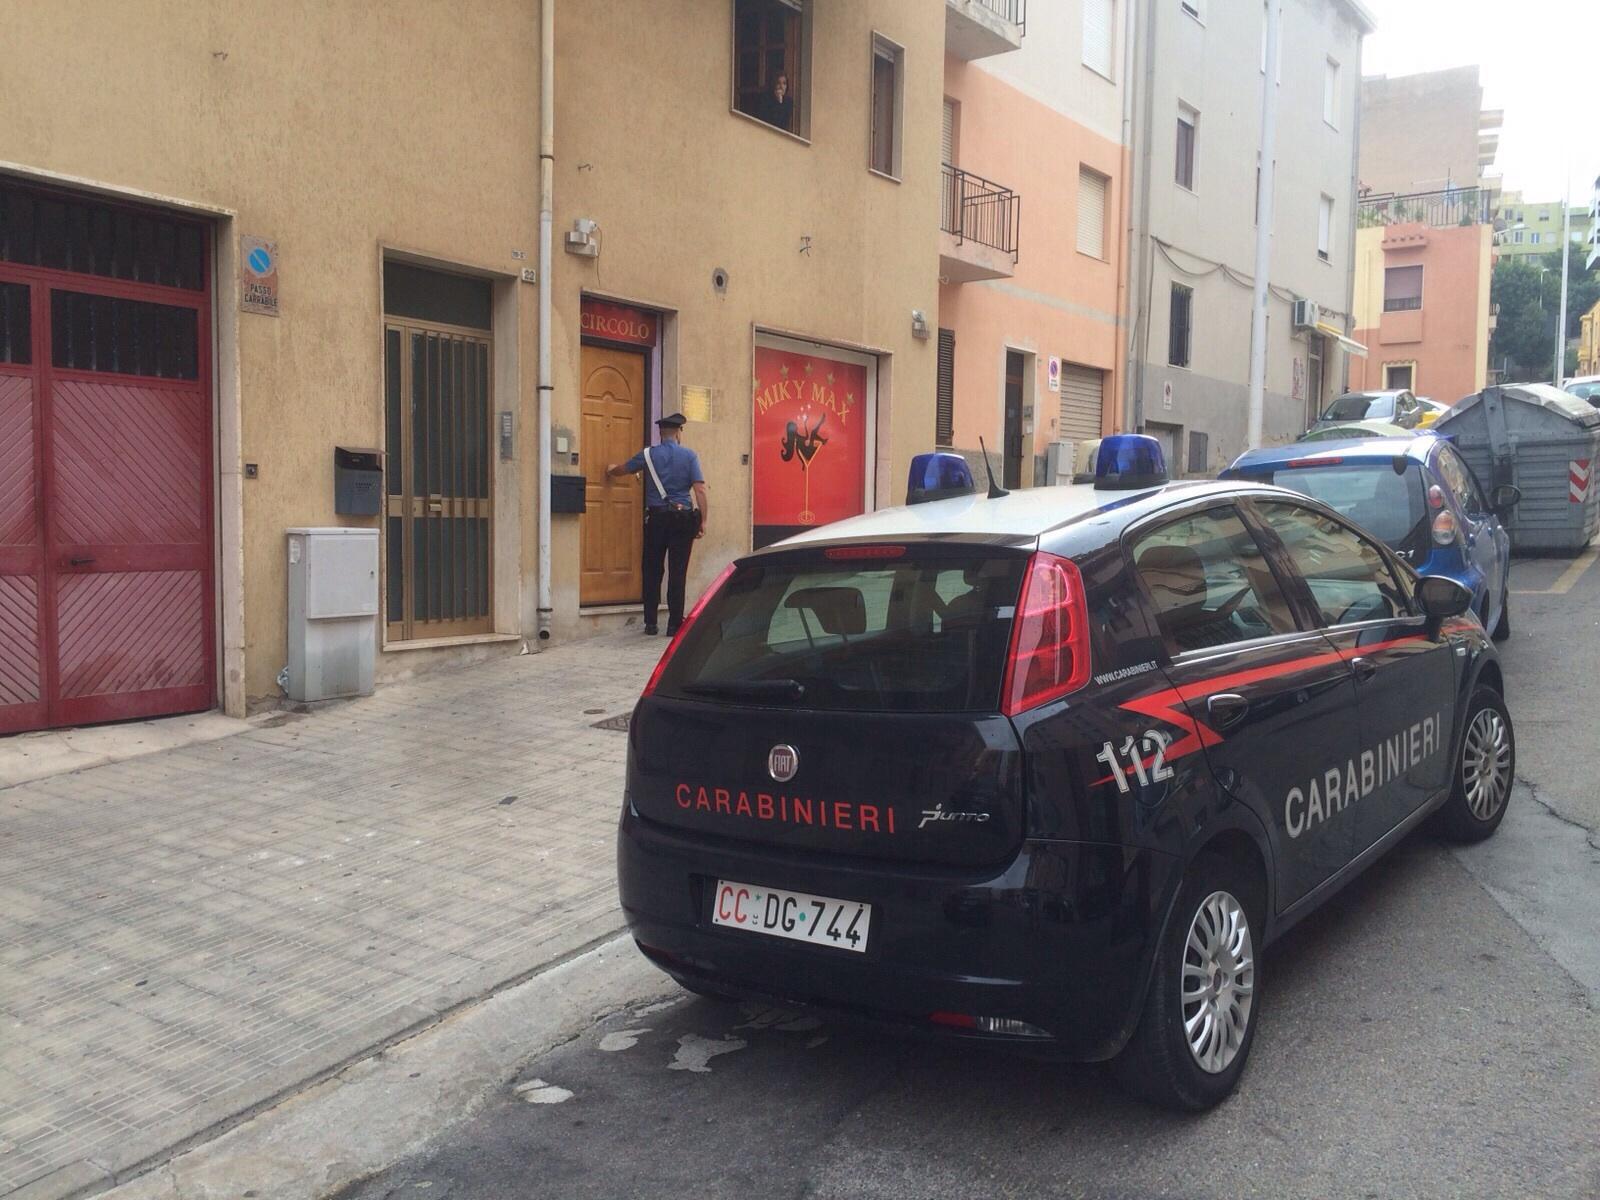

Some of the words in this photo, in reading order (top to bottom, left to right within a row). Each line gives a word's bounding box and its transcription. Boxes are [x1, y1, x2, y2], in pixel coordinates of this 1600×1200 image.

[524, 270, 535, 281] 22
[244, 293, 278, 307] CARRABILE
[250, 283, 272, 296] PASSO
[581, 312, 650, 339] CIRCOLO
[756, 379, 806, 415] MIKY
[811, 382, 850, 425] MAX
[1094, 660, 1159, 685] WWW.CARABINIERI.IT
[774, 754, 792, 773] FIAT
[1096, 729, 1175, 793] 112
[1285, 711, 1440, 838] CARABINIERI
[676, 783, 895, 834] CARABINIERI
[719, 886, 750, 923] CC
[764, 893, 797, 932] DG
[808, 900, 865, 945] 744
